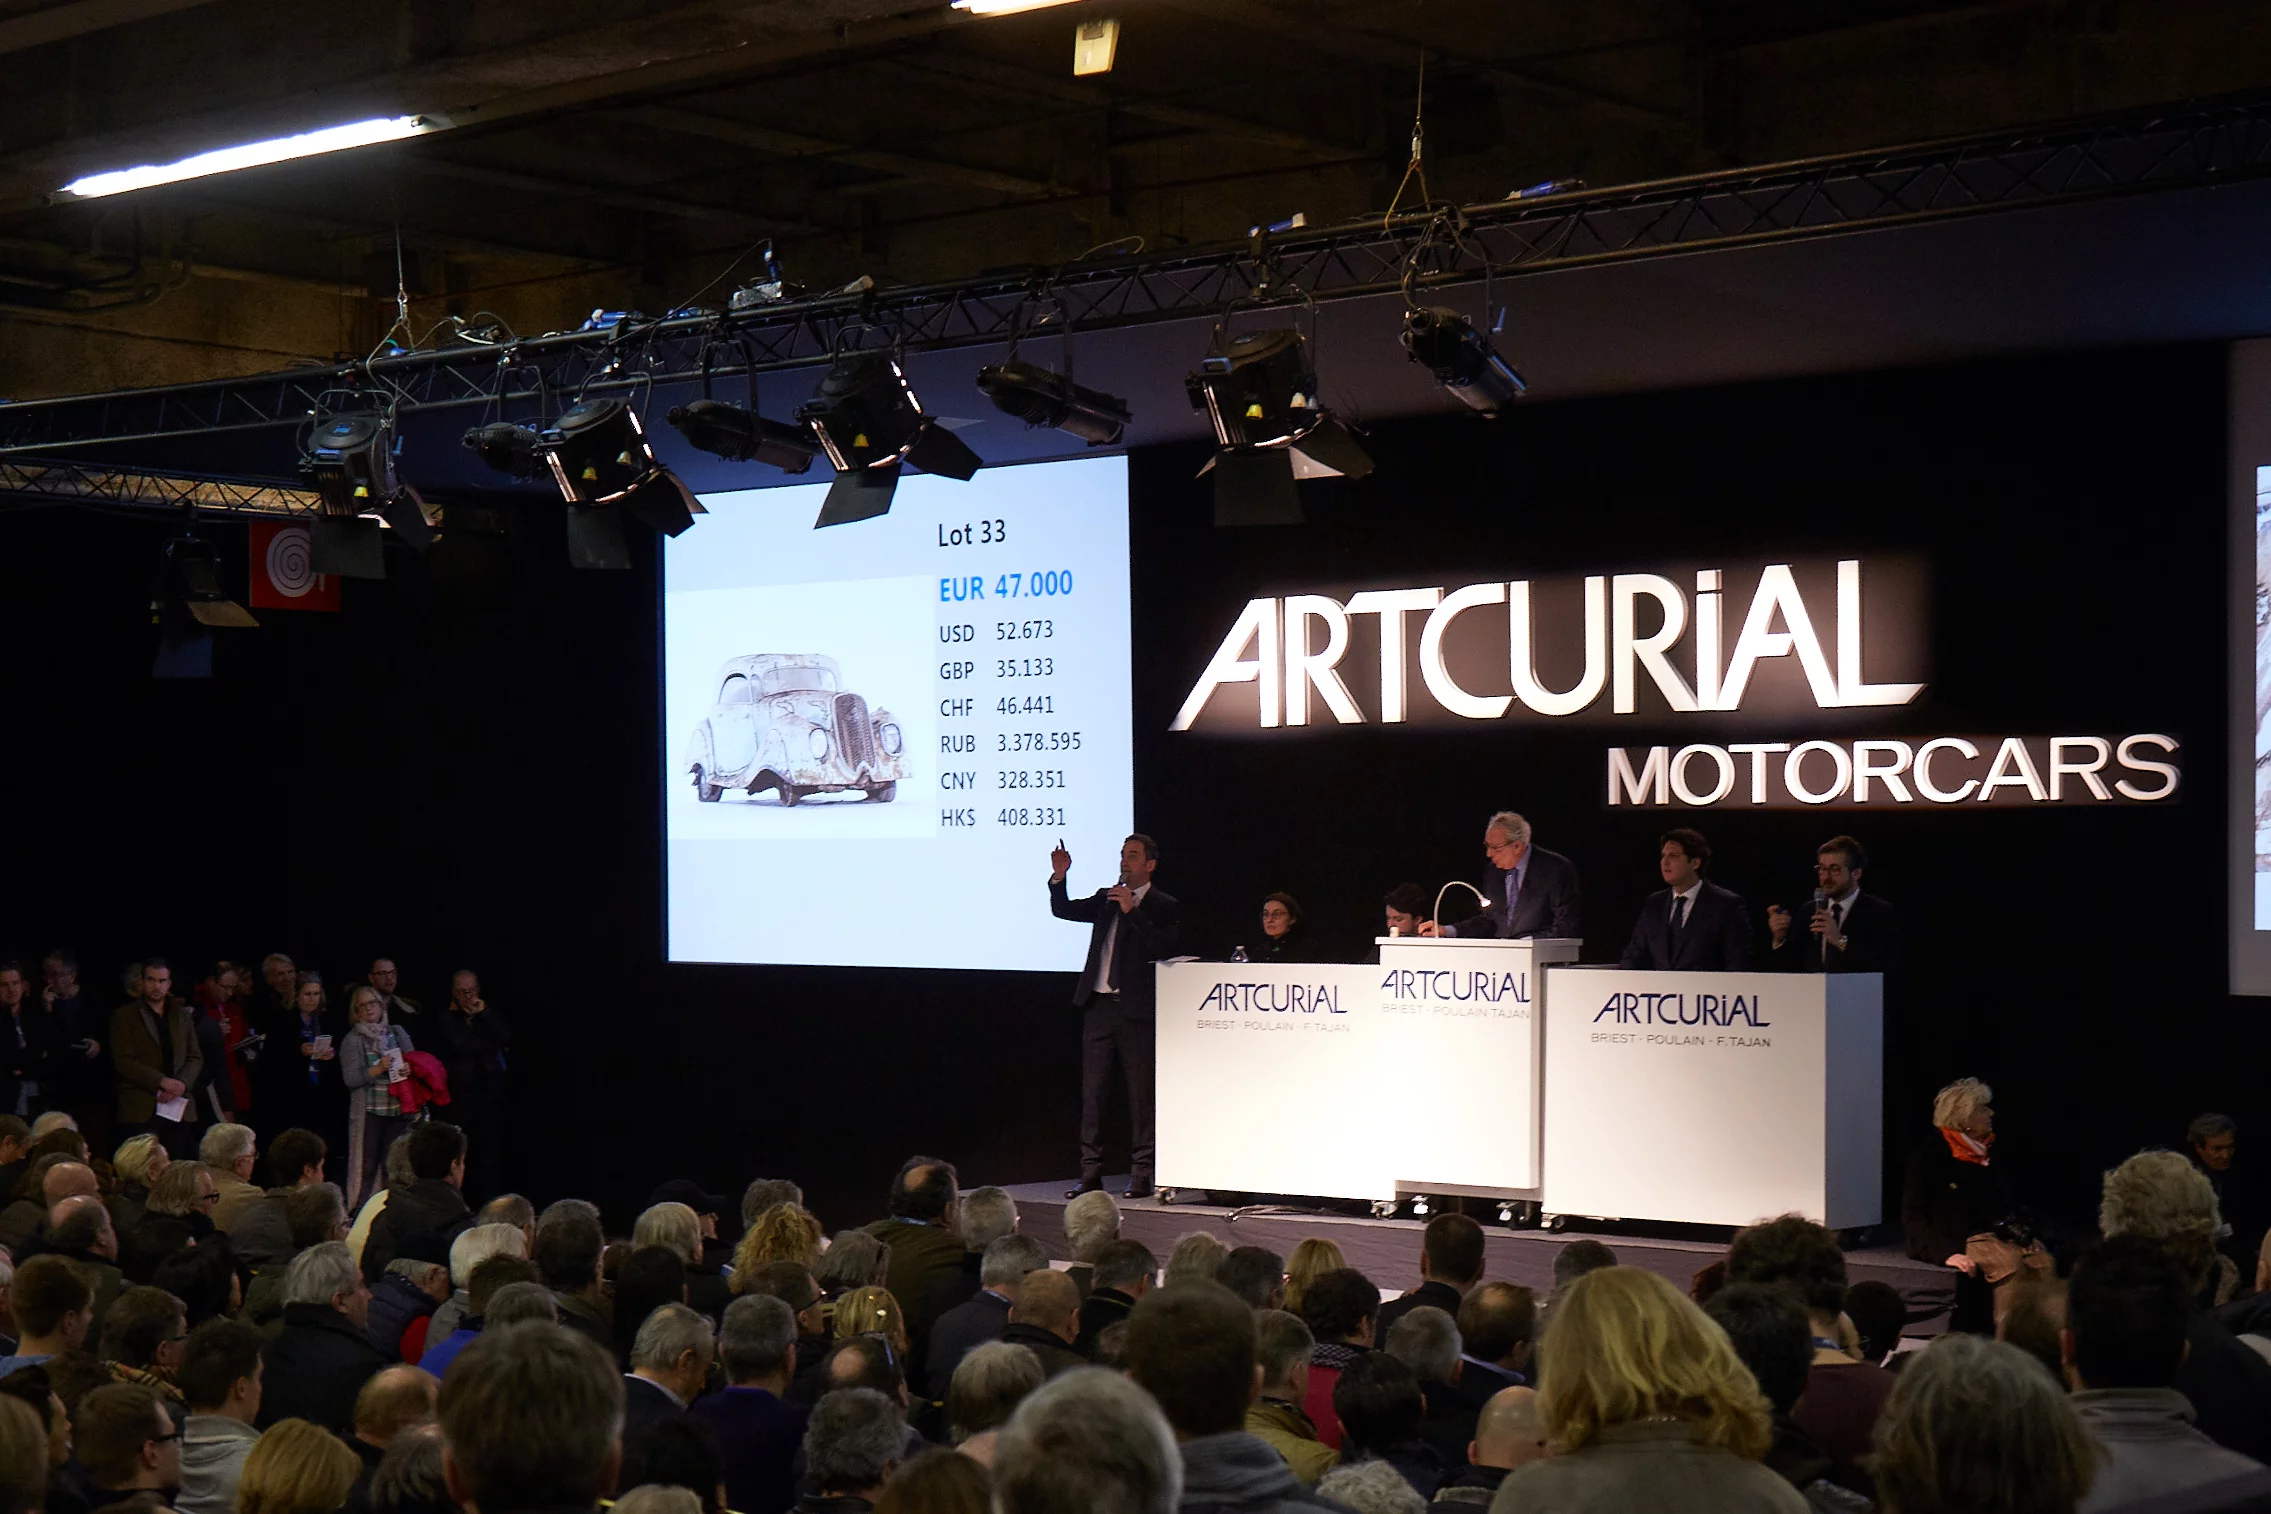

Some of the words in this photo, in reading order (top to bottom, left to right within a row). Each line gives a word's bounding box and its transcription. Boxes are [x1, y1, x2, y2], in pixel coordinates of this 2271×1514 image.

[938, 523, 972, 547] Lot
[980, 519, 1006, 544] 33
[940, 576, 985, 602] EUR
[994, 569, 1073, 599] 47.000
[940, 624, 975, 643] USD
[997, 620, 1053, 640] 52.673
[940, 661, 974, 680] GBP
[997, 658, 1053, 678] 35.133
[940, 698, 973, 717] CHF
[996, 695, 1054, 715] 46.441
[941, 735, 976, 753] RUB
[998, 731, 1081, 752] 3.378.595
[941, 771, 976, 790] CNY
[998, 770, 1065, 789] 328.351
[1608, 734, 2181, 806] MOTORCARS
[998, 807, 1066, 827] 408.331
[1382, 1003, 1423, 1014] BRIEST
[1433, 1005, 1487, 1018] POULAIN
[1197, 1019, 1236, 1030] BRIEST
[1244, 1021, 1294, 1032] POULAIN
[1591, 1033, 1635, 1044] BRIEST
[1647, 1034, 1705, 1046] POULAIN
